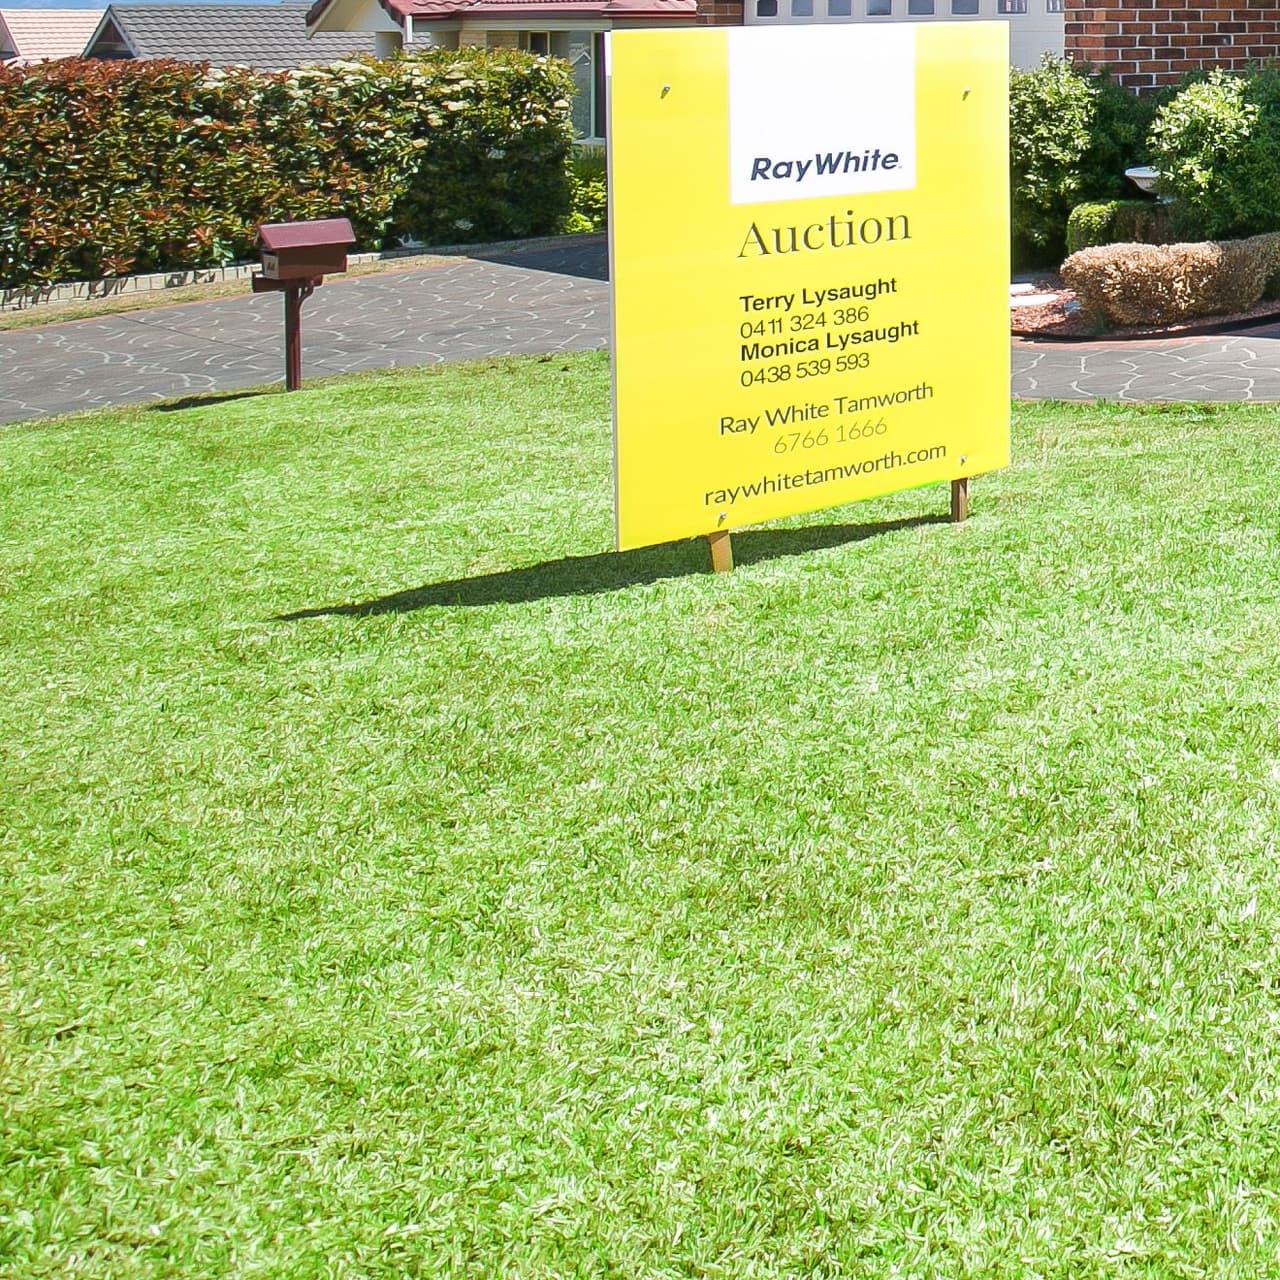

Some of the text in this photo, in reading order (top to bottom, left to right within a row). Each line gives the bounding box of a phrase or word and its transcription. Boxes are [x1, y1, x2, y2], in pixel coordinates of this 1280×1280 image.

[737, 210, 912, 258] Auction
[739, 278, 897, 312] Terry Lysaught
[740, 306, 869, 339] 0411 324 386
[741, 320, 919, 361] Monica Lysaught
[740, 352, 870, 387] 0438 539 593
[720, 382, 933, 436] Ray White Tamworth
[774, 417, 888, 454] 6766 1666
[705, 444, 947, 506] raywhitetamworth.com
